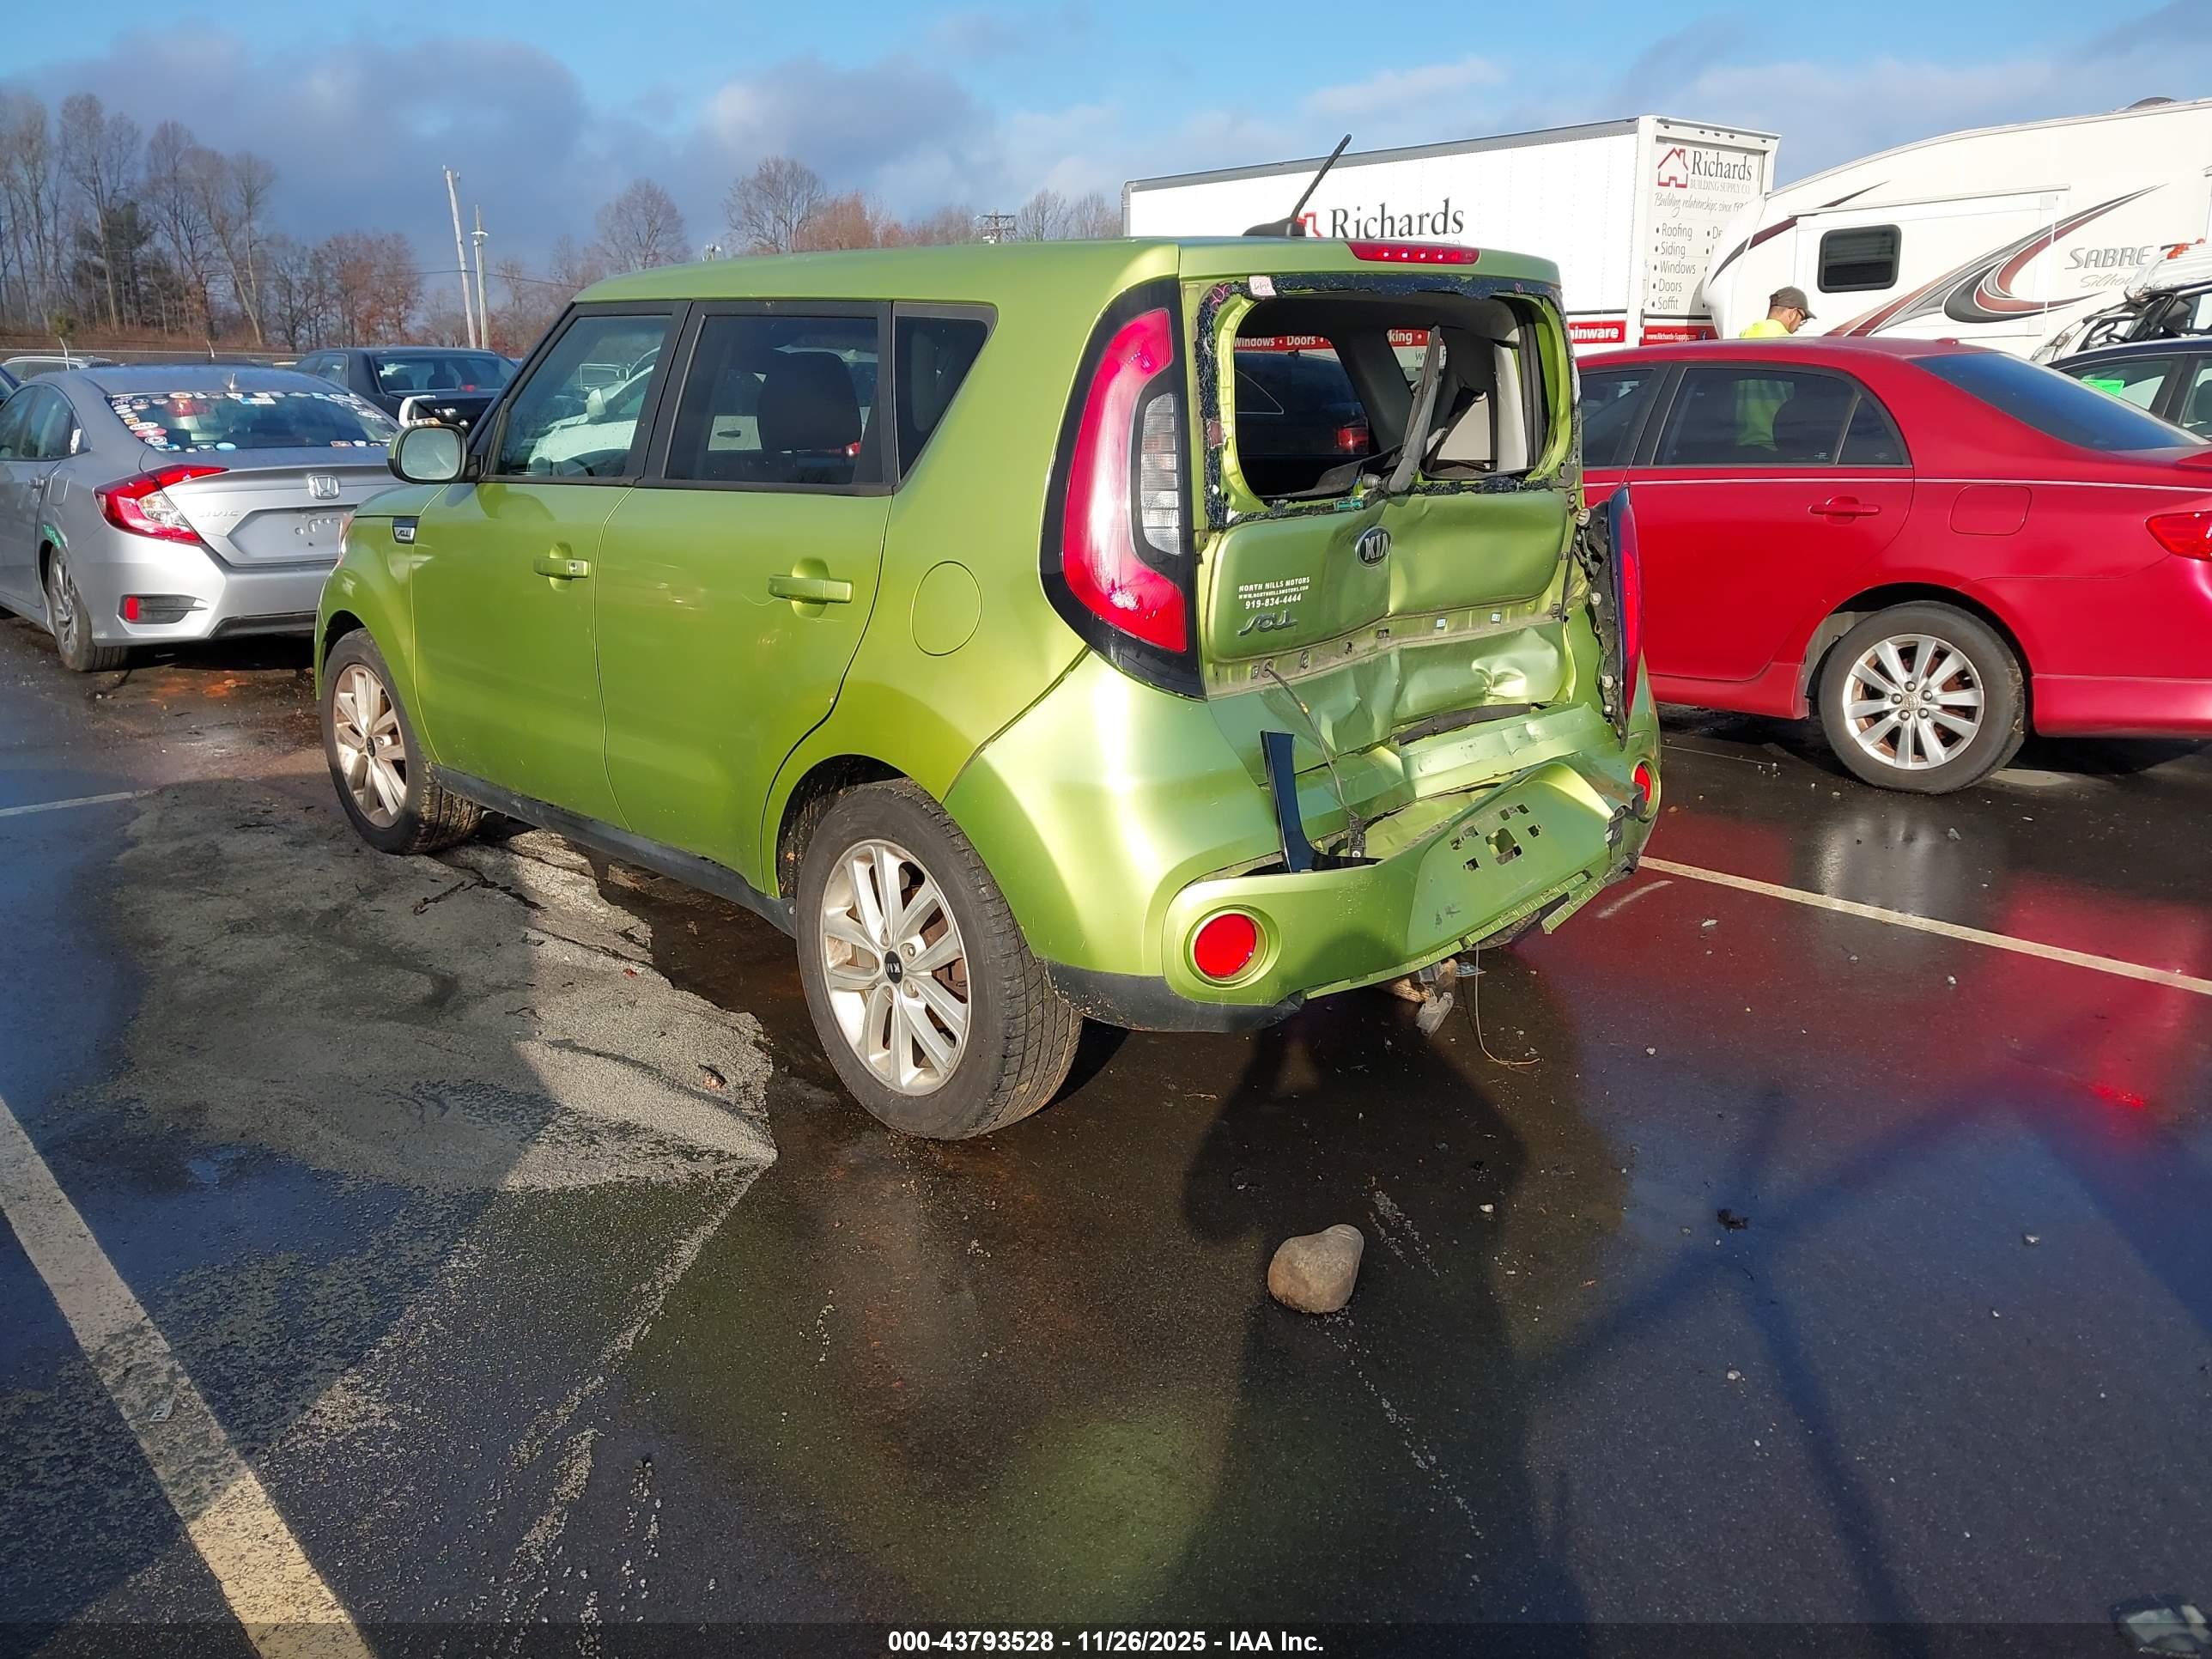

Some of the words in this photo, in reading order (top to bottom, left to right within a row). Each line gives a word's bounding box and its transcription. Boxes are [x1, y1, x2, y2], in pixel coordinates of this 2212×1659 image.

[1692, 150, 1753, 181] Richards
[1690, 178, 1719, 191] BUILDING
[1720, 181, 1740, 193] SUPPLY
[1655, 191, 1681, 218] Building
[1330, 197, 1464, 240] Richards
[1662, 222, 1692, 241] Roofing
[1661, 241, 1686, 258] Siding
[2064, 246, 2154, 270] SABRE
[1660, 260, 1696, 275] Windows
[1658, 278, 1682, 292] Doors
[1657, 296, 1679, 310] Soffit
[1235, 337, 1275, 348] Windows
[1286, 336, 1316, 346] Doors
[1364, 533, 1389, 561] KIA
[1238, 584, 1263, 592] NORTH
[1265, 580, 1284, 590] HILLS
[1285, 576, 1310, 586] MOTORS
[1245, 592, 1302, 610] 919-834-4444
